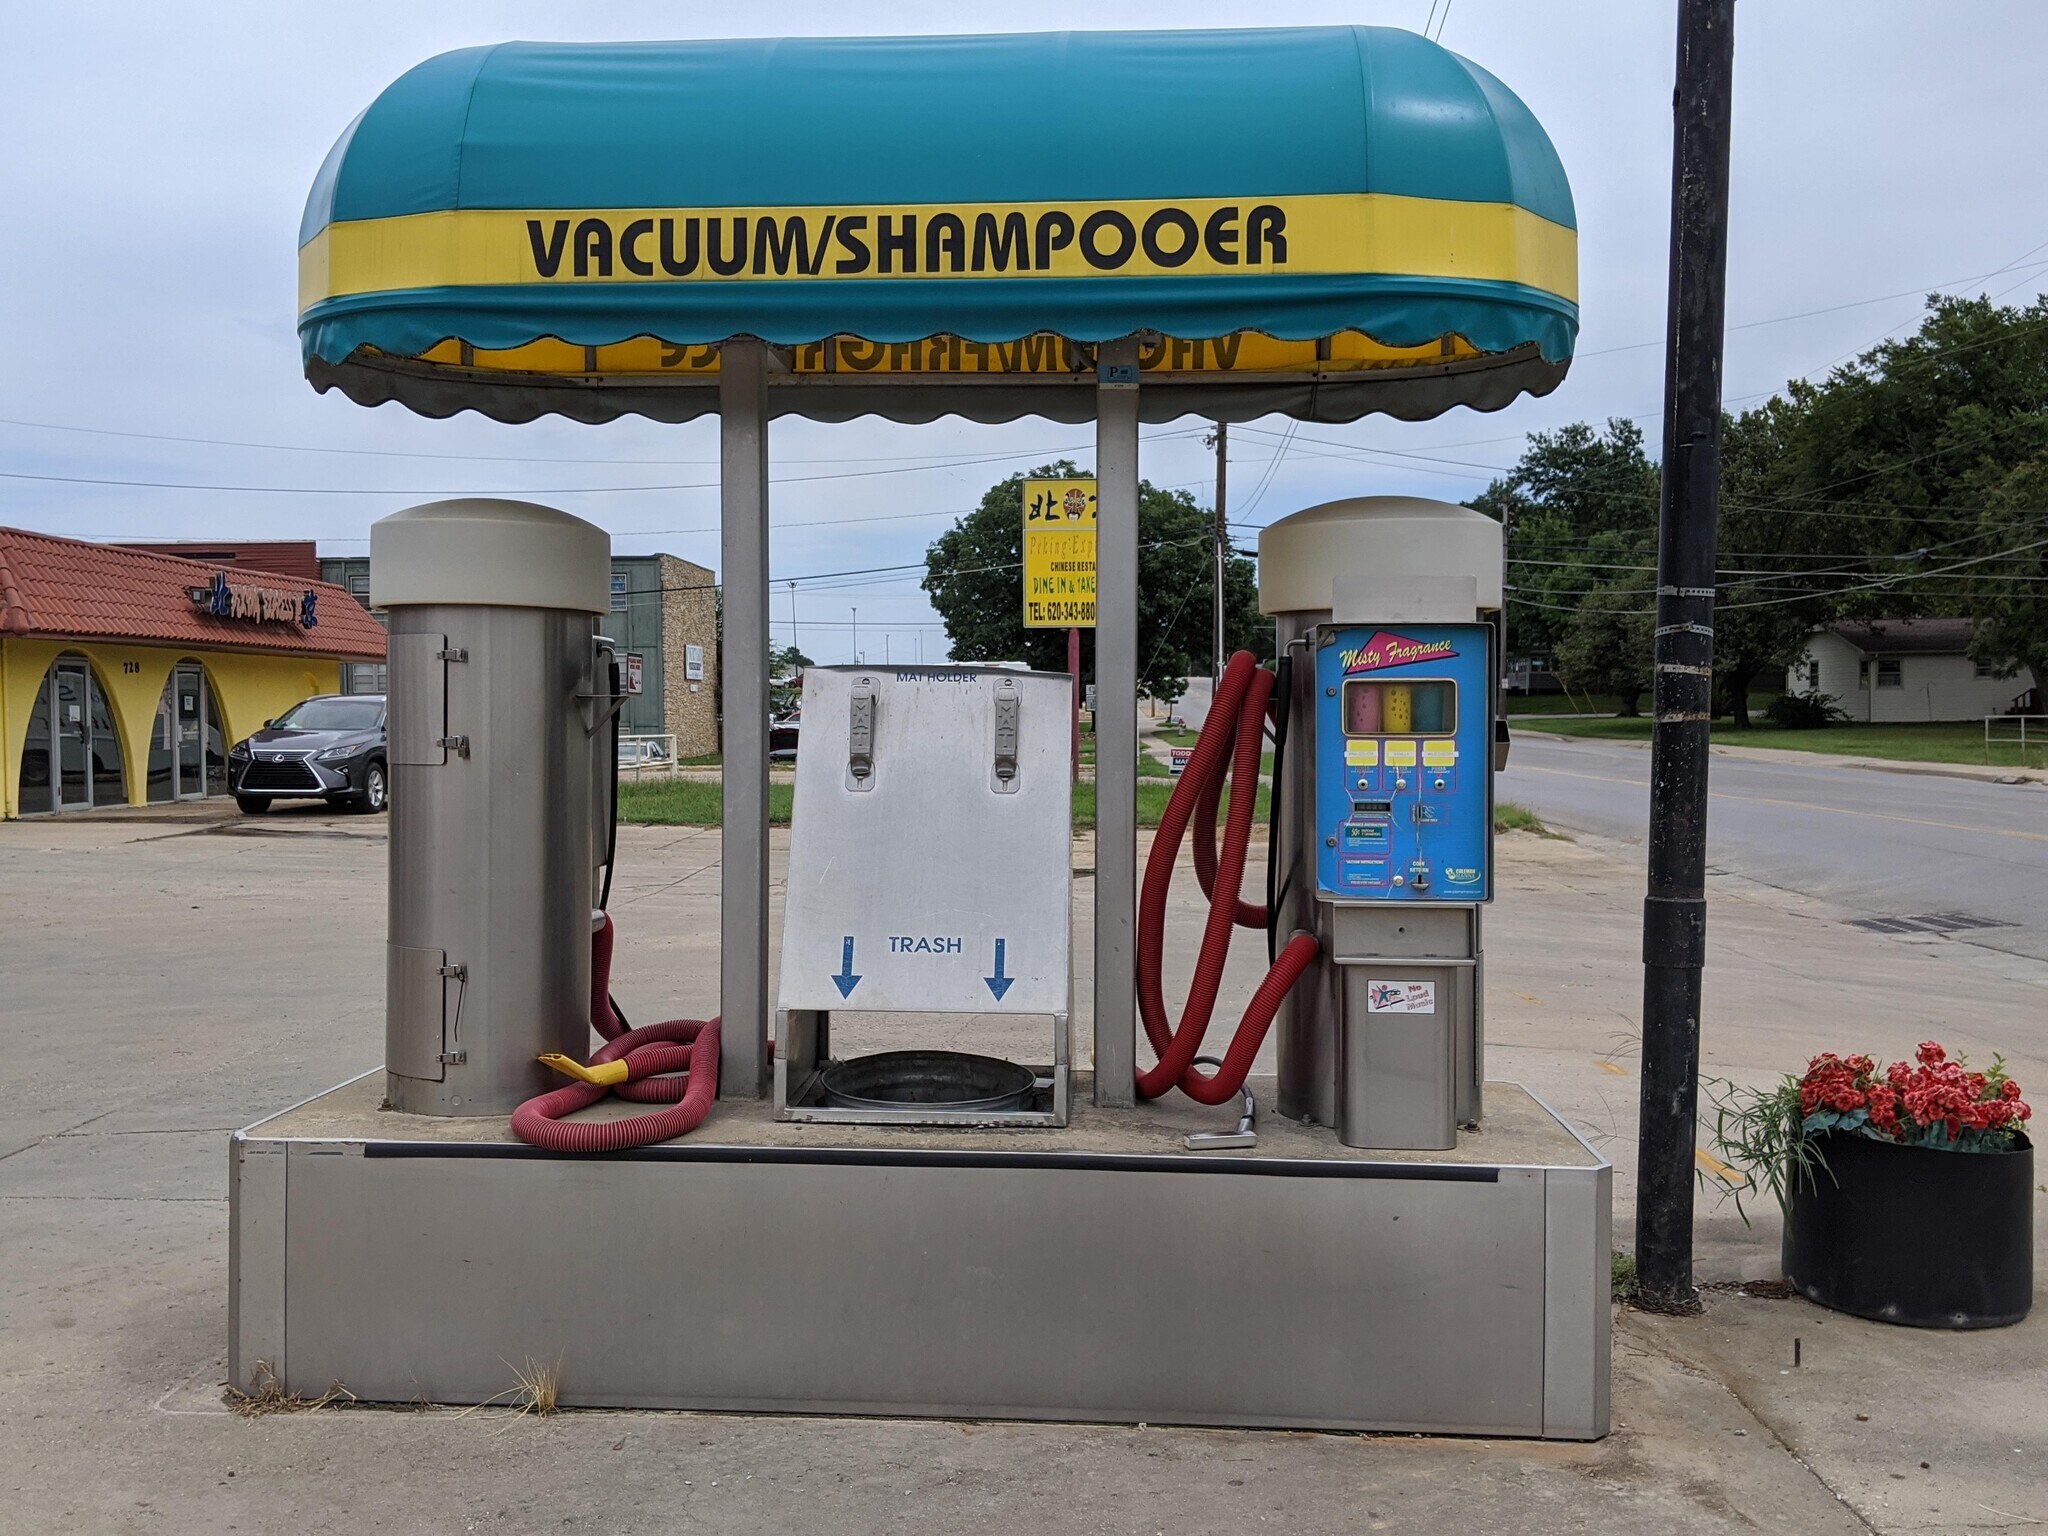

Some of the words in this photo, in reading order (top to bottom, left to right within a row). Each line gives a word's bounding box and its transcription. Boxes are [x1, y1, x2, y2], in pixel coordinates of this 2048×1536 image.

[526, 205, 1288, 278] VACUUM/SHAMPOOER
[1028, 489, 1060, 521] 北
[1050, 562, 1076, 572] CHINESE
[1033, 577, 1055, 594] DINE
[1057, 577, 1067, 594] IN
[1069, 580, 1075, 593] &
[1077, 576, 1096, 594] TAKE
[1029, 602, 1046, 621] TEL:
[1339, 649, 1381, 668] Misty
[1386, 640, 1452, 663] Fragrance
[123, 662, 140, 674] 728
[896, 672, 923, 682] MAT
[927, 672, 977, 682] HOLDER
[889, 937, 962, 953] TRASH
[1408, 985, 1422, 993] No
